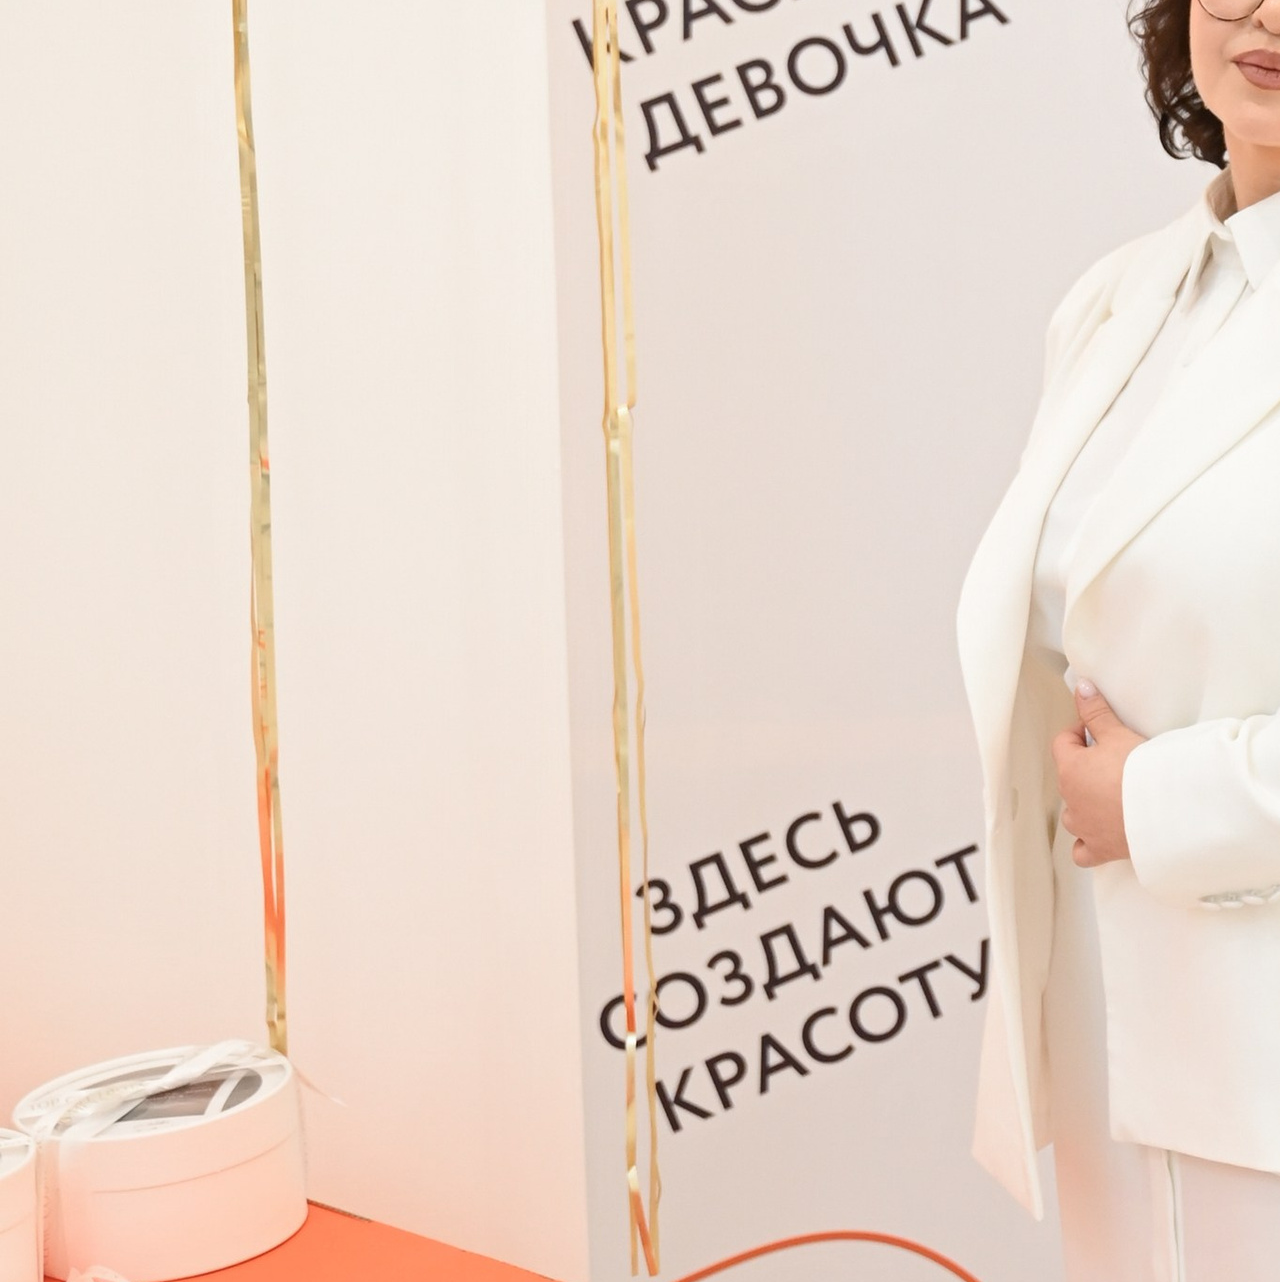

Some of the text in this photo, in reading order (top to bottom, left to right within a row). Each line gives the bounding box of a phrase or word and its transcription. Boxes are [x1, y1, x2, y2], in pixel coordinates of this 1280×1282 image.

[598, 843, 979, 1052] СОЗДАЮТ
[634, 800, 882, 937] ЗДЕСЬ
[653, 937, 991, 1134] КРАСОТУ
